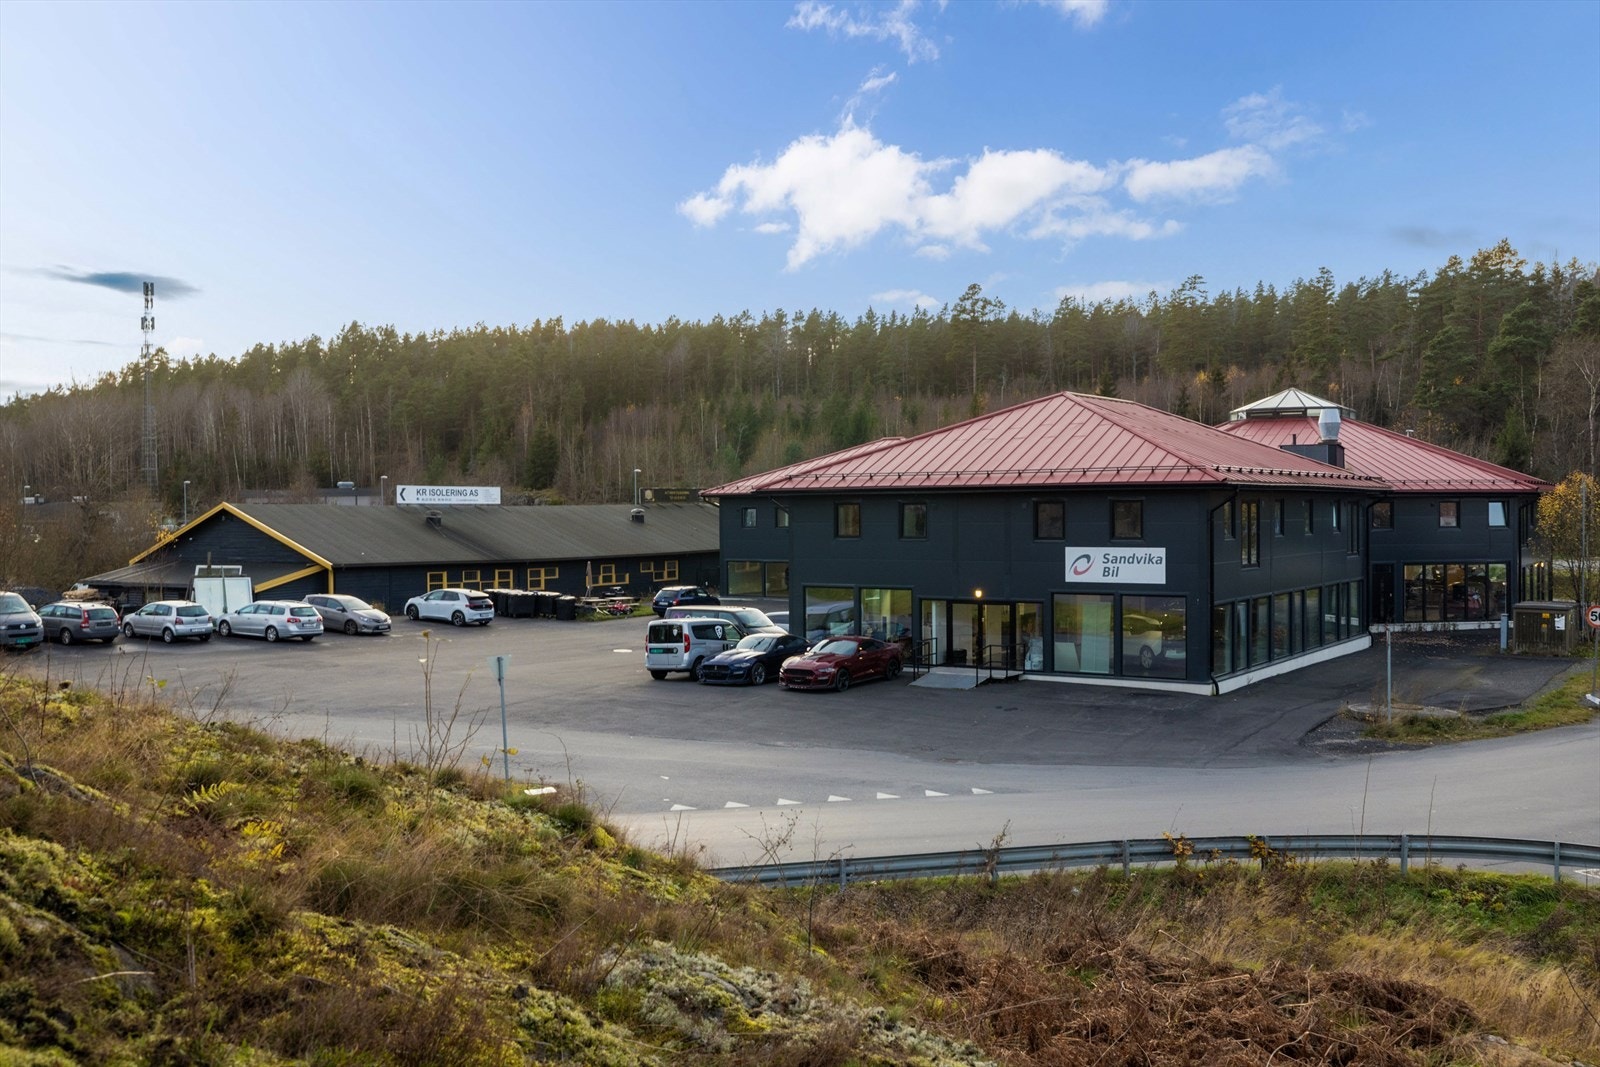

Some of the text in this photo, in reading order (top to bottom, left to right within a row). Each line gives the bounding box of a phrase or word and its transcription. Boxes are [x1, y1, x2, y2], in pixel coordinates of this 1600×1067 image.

[416, 488, 427, 496] KR
[428, 488, 468, 497] ISOLERING
[469, 489, 479, 497] AS
[1102, 553, 1163, 565] Sandvika
[1102, 566, 1120, 578] Bil
